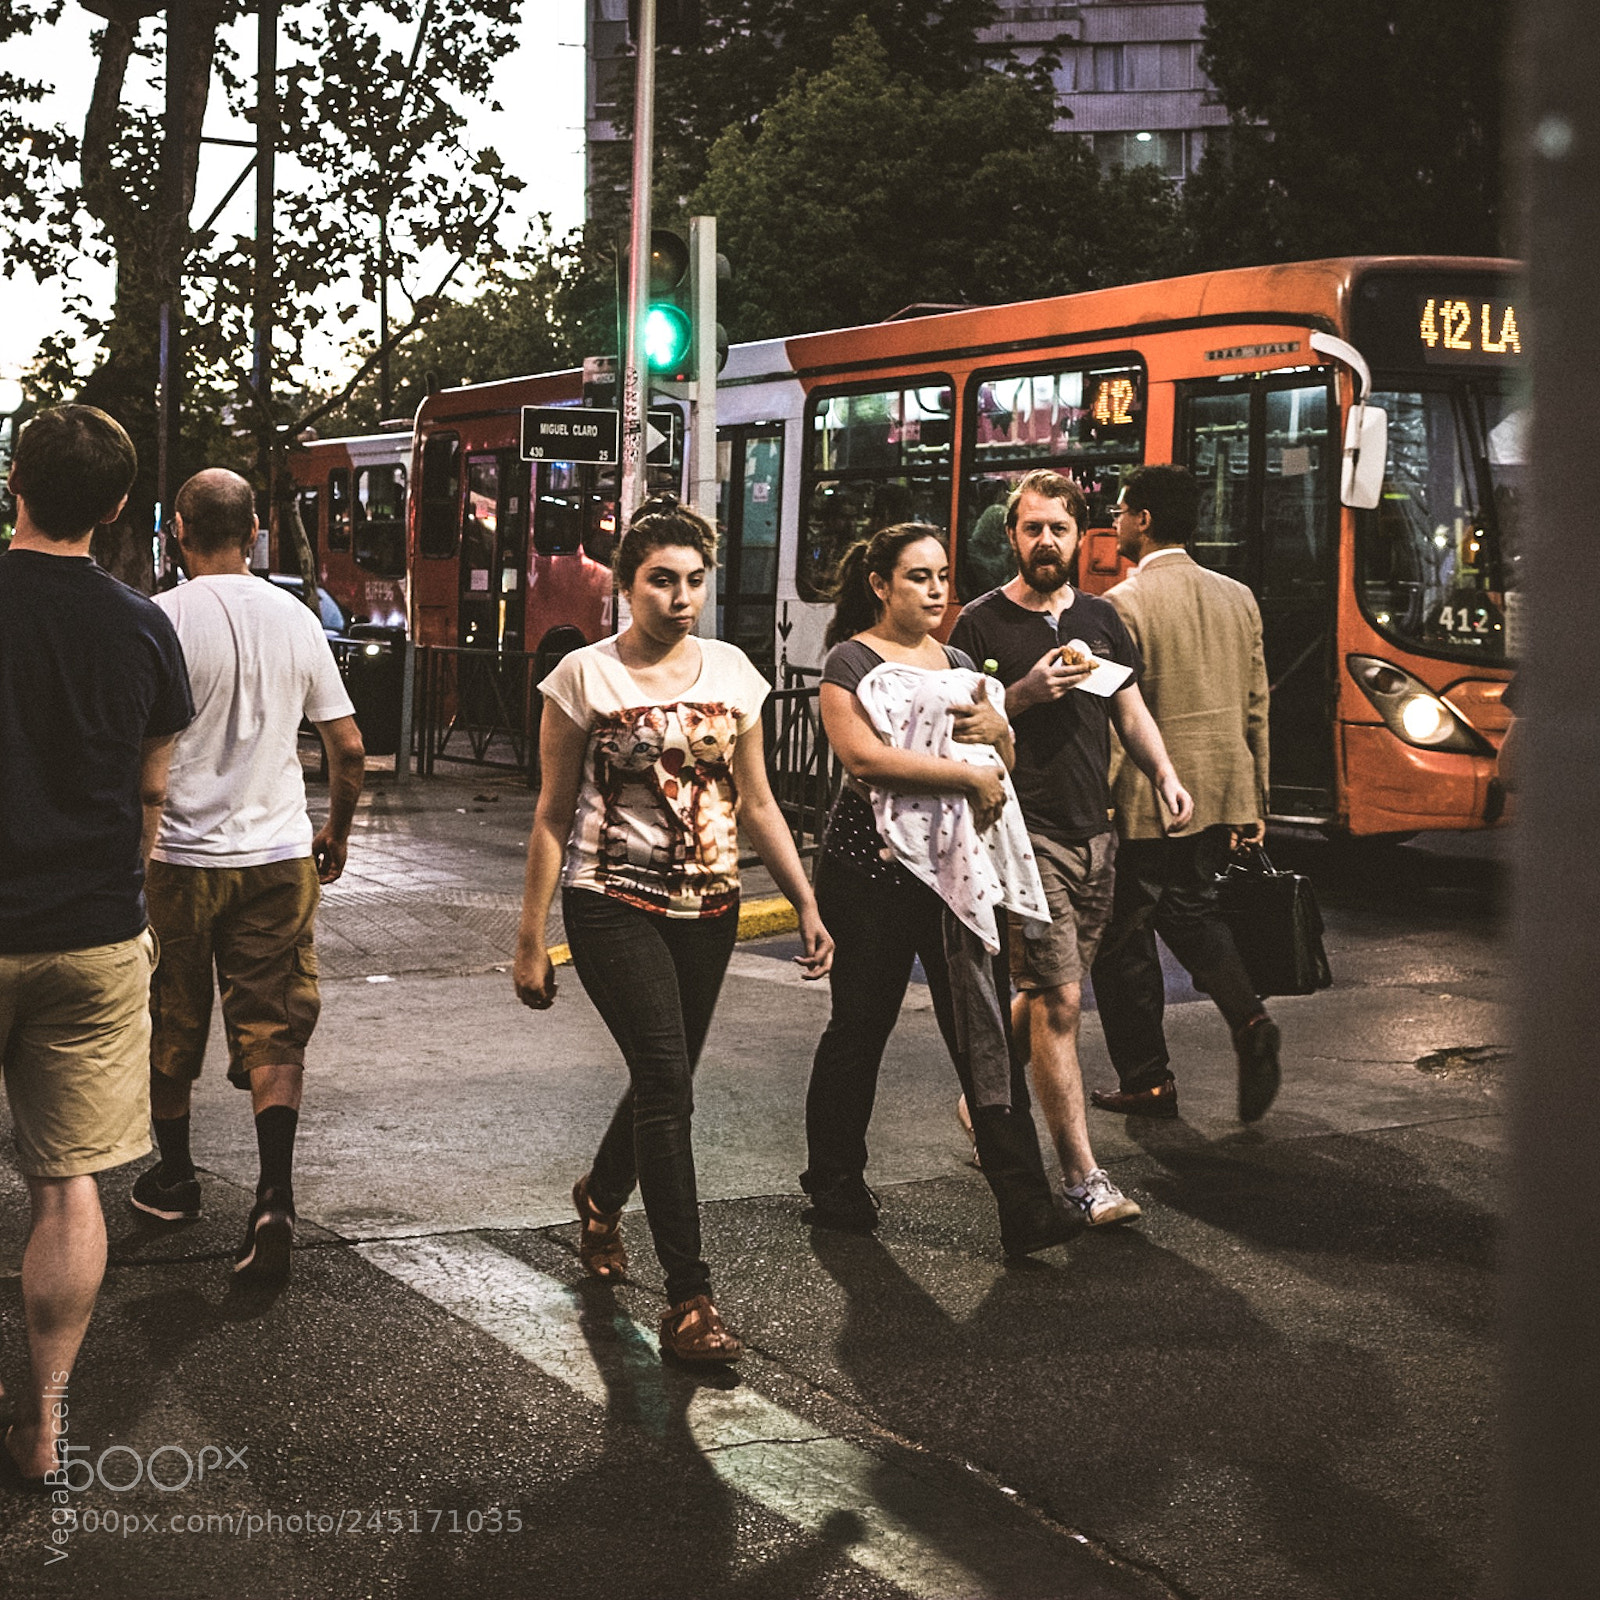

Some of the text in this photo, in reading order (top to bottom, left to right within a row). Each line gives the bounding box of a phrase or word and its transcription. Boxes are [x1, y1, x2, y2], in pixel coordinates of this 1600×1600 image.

[1420, 299, 1521, 353] 412 LA
[540, 423, 598, 437] MIGUEL CLARO
[529, 446, 608, 461] 430 25
[1439, 606, 1489, 633] 412
